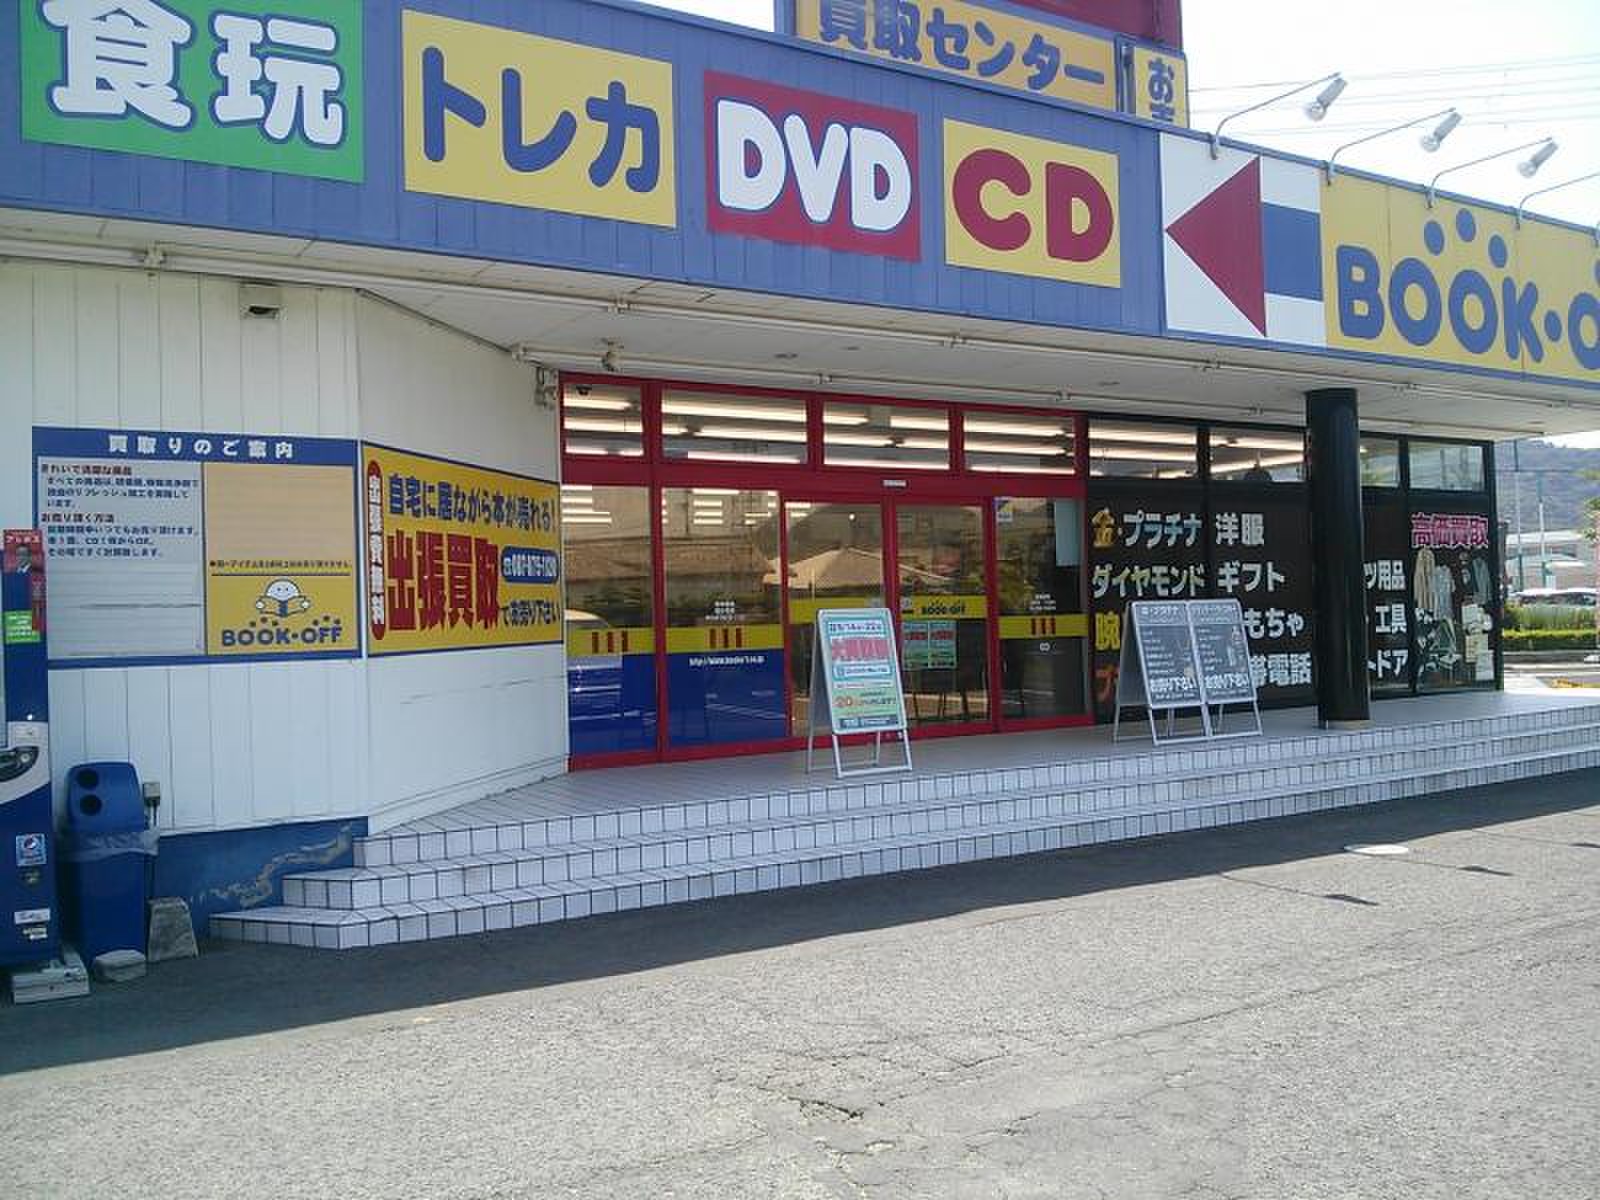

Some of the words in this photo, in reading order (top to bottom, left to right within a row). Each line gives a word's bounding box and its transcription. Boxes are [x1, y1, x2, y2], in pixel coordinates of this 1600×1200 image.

[40, 0, 344, 145] 食玩
[422, 46, 661, 193] トレカ
[716, 98, 913, 233] DVD
[952, 147, 1115, 263] CD
[108, 434, 294, 460] 買取りのご案内
[1215, 512, 1265, 546] 洋服
[1411, 512, 1489, 549] 高価買取
[387, 529, 500, 632] 出張買取
[1092, 562, 1205, 598] ダイヤモンド
[1217, 561, 1285, 593] ギフト
